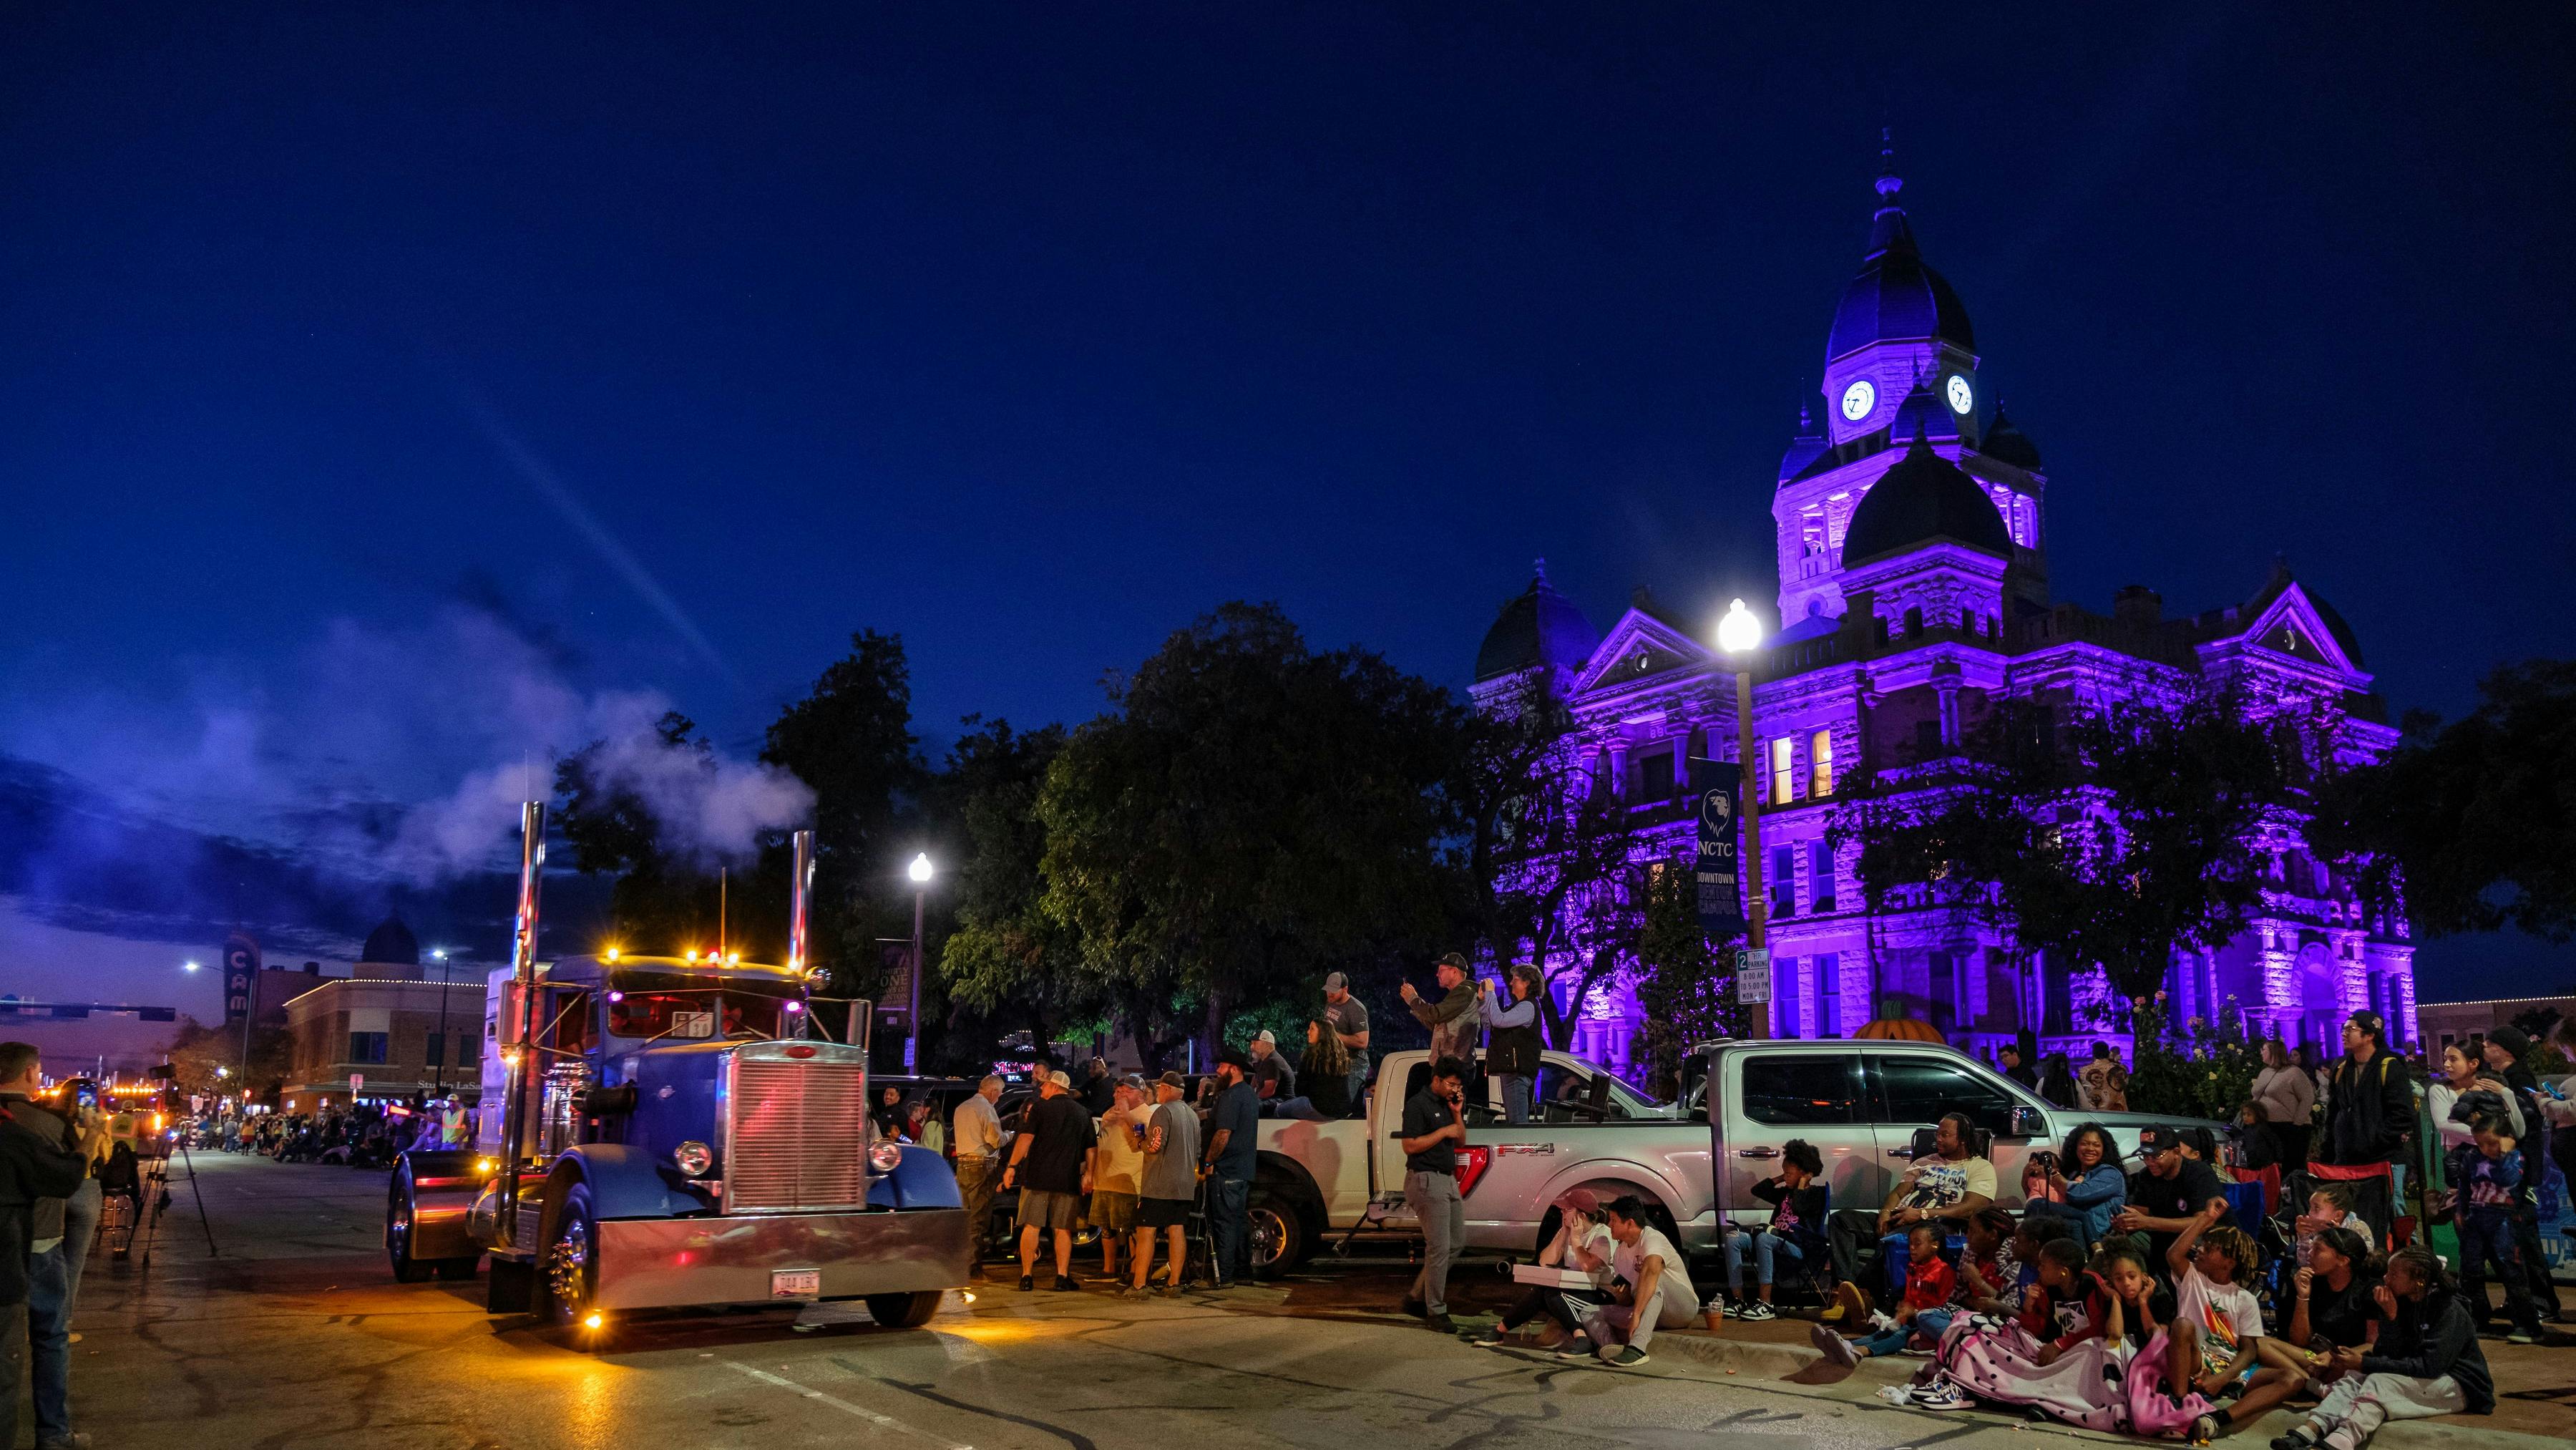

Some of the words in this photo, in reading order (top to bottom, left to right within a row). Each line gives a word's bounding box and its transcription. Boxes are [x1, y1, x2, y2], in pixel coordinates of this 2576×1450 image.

[1698, 841, 1733, 857] NCTC
[1697, 872, 1735, 885] DOWNTOWN
[1740, 955, 1747, 968] 2
[1748, 960, 1768, 968] PARKING
[880, 975, 909, 988] ONE
[1496, 1143, 1555, 1157] FX4
